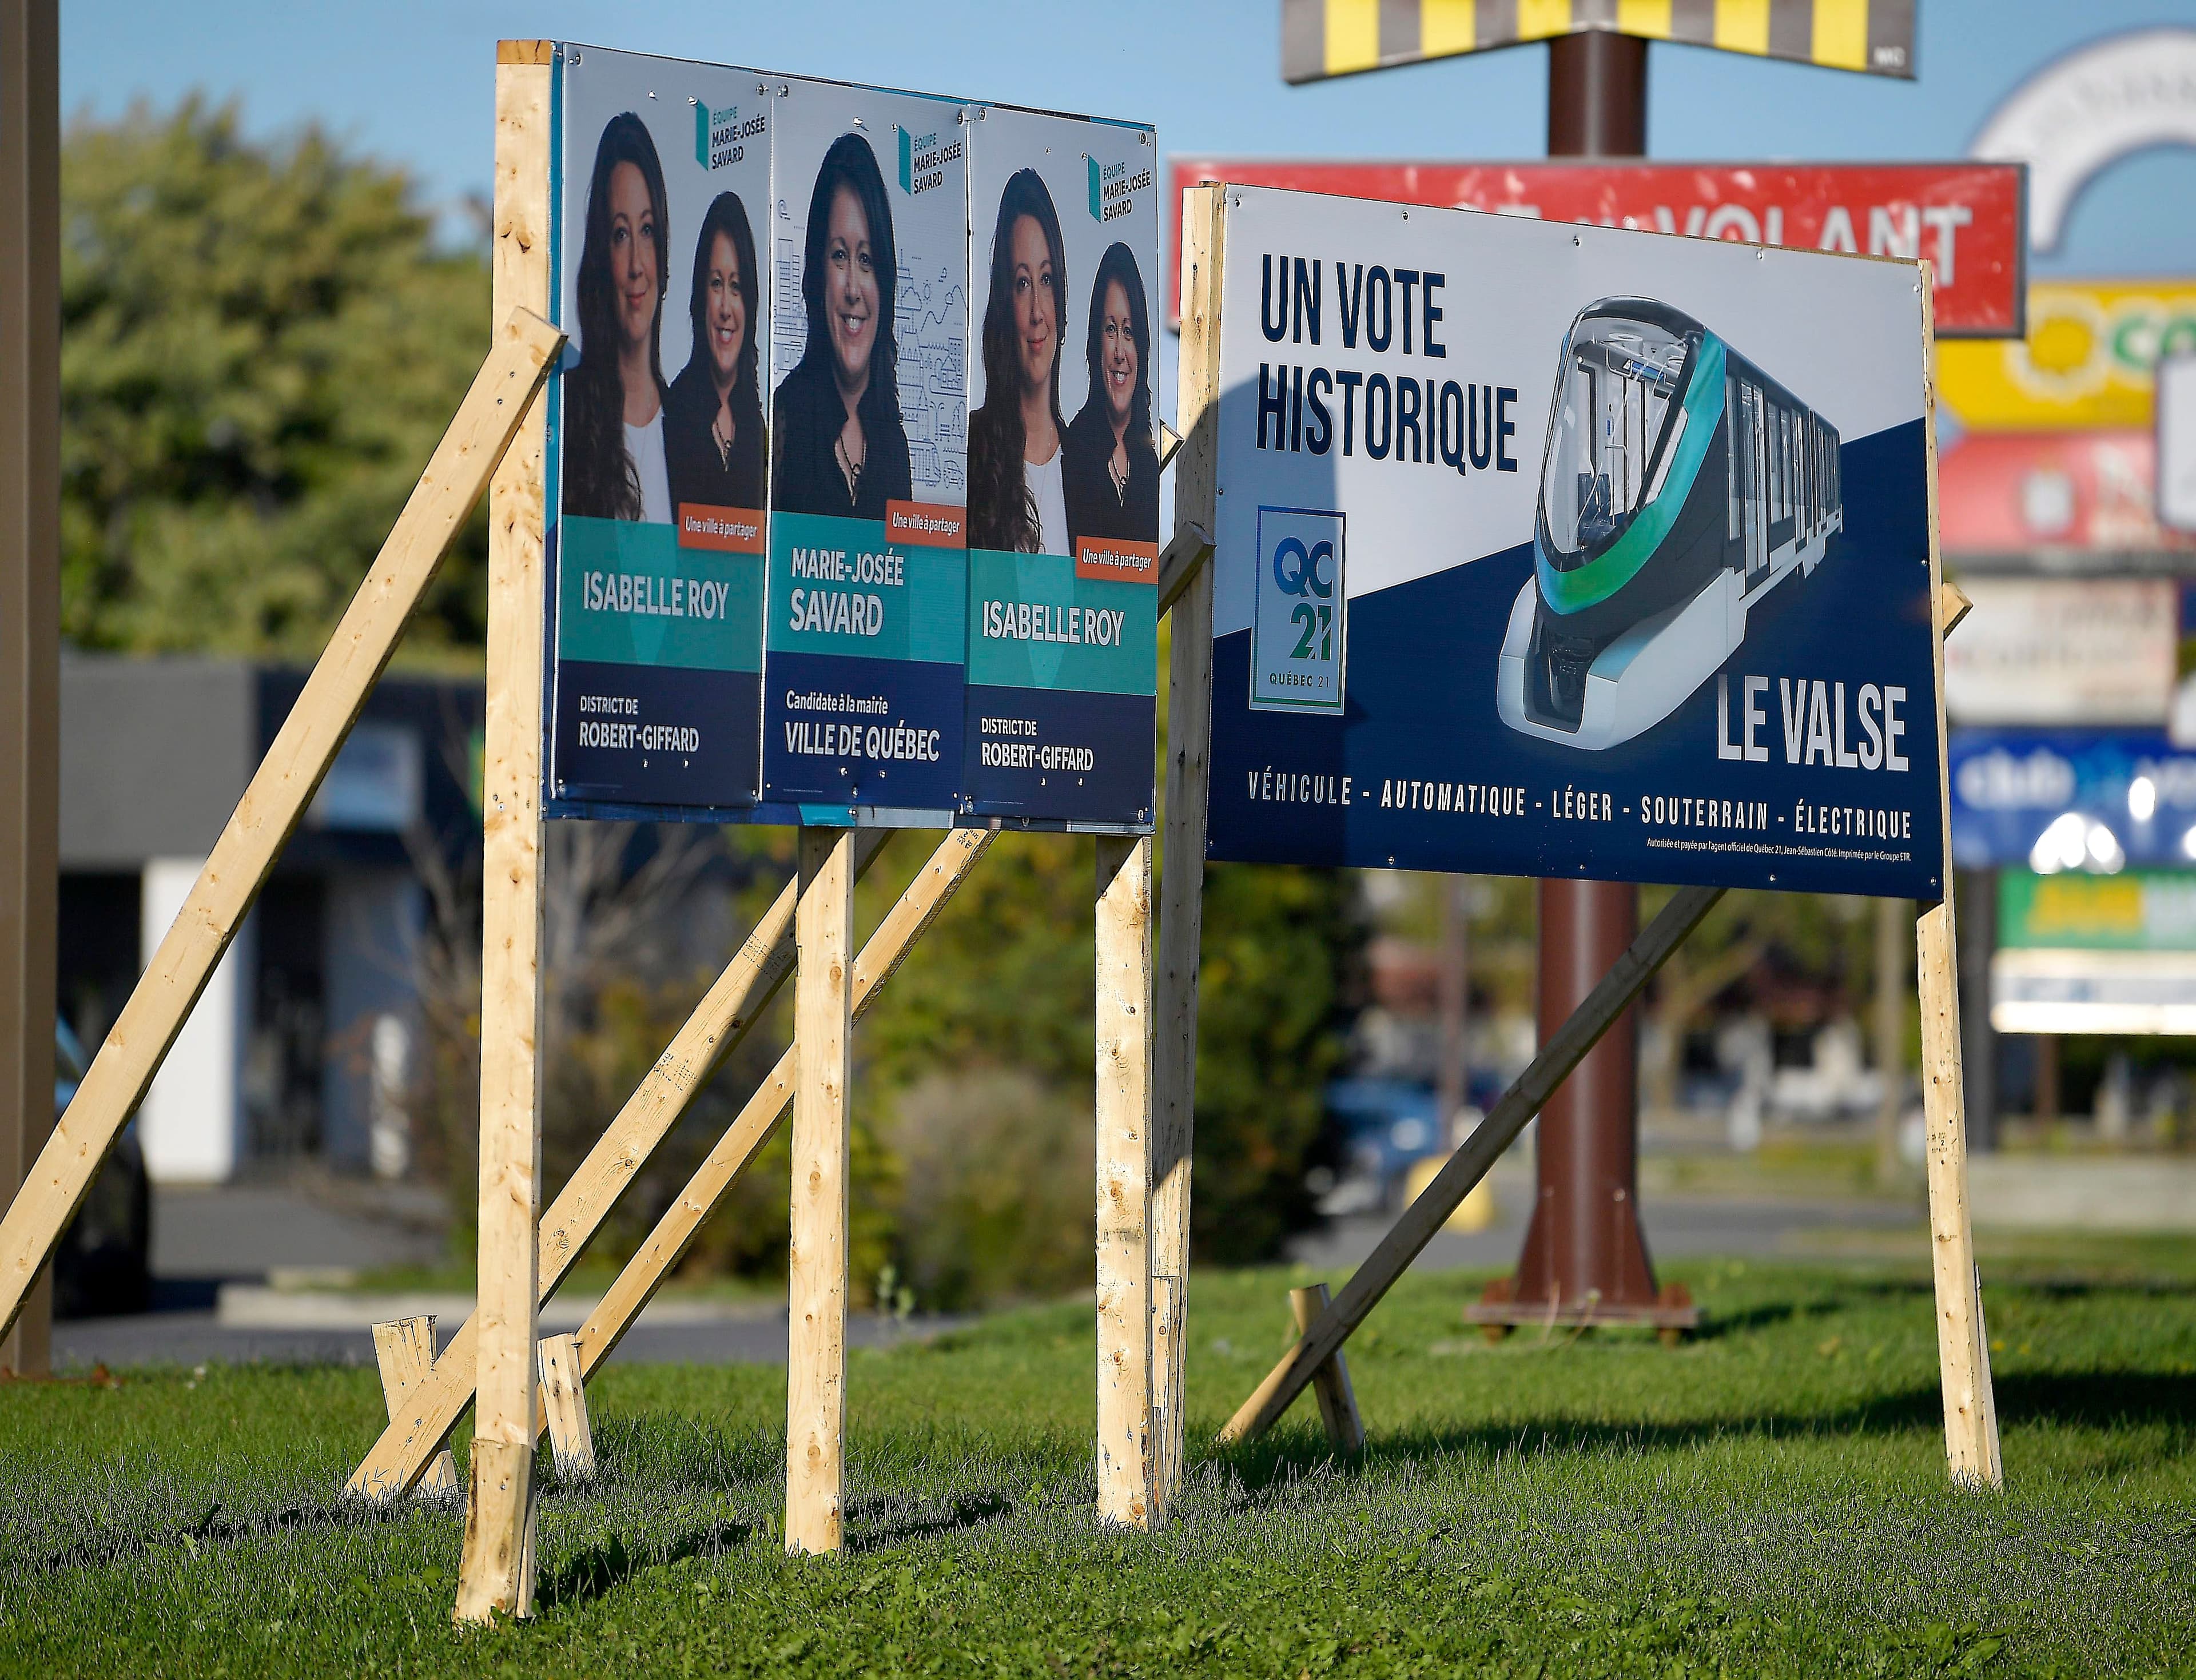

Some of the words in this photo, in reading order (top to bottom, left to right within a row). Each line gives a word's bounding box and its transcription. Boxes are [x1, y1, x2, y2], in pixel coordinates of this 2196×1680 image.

[712, 113, 765, 148] MARIE-JOSÉE
[914, 133, 936, 152] ÉQUIPE
[712, 145, 743, 170] SAVARD
[914, 139, 961, 173] MARIE-JOSÉE
[1103, 161, 1125, 181] ÉQUIPE
[914, 170, 943, 194] SAVARD
[1103, 168, 1151, 202] MARIE-JOSÉE
[1104, 198, 1132, 222] SAVARD
[1260, 253, 1322, 345] UN
[1335, 261, 1446, 359] VOTE
[1256, 362, 1518, 476] HISTORIQUE
[892, 512, 908, 528] Une
[908, 513, 924, 530] ville
[929, 517, 960, 536] partager
[790, 547, 904, 586] MARIE-JOSÉE
[1083, 548, 1097, 563] Une
[1099, 550, 1114, 566] ville
[1115, 551, 1119, 566] à
[1119, 553, 1152, 572] partager
[1273, 536, 1334, 598] QC
[583, 570, 684, 618] ISABELLE
[688, 578, 730, 620] ROY
[789, 588, 884, 636] SAVARD
[982, 600, 1080, 643] ISABELLE
[1084, 608, 1125, 646] ROY
[1288, 602, 1332, 661] 21
[1269, 670, 1313, 687] QUÉBEC
[1318, 676, 1330, 687] 21
[580, 695, 624, 714] DISTRICT
[626, 699, 639, 715] DE
[786, 690, 837, 711] Candidate
[838, 693, 845, 711] à
[846, 694, 855, 712] la
[856, 696, 888, 714] mairie
[579, 720, 699, 753] ROBERT-GIFFARD
[981, 718, 1024, 735] DISTRICT
[1025, 721, 1037, 737] DE
[1718, 674, 1768, 763] LE
[1780, 677, 1909, 772] VALSE
[785, 722, 836, 755] VILLE
[839, 724, 862, 757] DE
[865, 719, 940, 762] QUÉBEC
[981, 742, 1094, 771] ROBERT-GIFFARD
[1248, 766, 1352, 805] VÉHICULE
[1381, 779, 1525, 817] AUTOMATIQUE
[1553, 784, 1612, 821] LÉGER
[1641, 795, 1768, 830] SOUTERRAIN
[1795, 798, 1912, 839] ÉLECTRIQUE
[1647, 837, 1673, 848] Autorisée
[1674, 839, 1680, 849] et
[1681, 840, 1697, 851] payée
[1698, 842, 1708, 851] par
[1708, 841, 1727, 853] l'agent
[1728, 842, 1745, 852] officiel
[1746, 842, 1753, 852] de
[1754, 843, 1774, 854] Québec
[1775, 845, 1783, 855] 21,
[1784, 846, 1824, 857] Jean-Sébastien
[1839, 848, 1864, 860] Imprimée
[1864, 851, 1874, 861] par
[1874, 850, 1879, 859] le
[1880, 851, 1899, 862] Groupe
